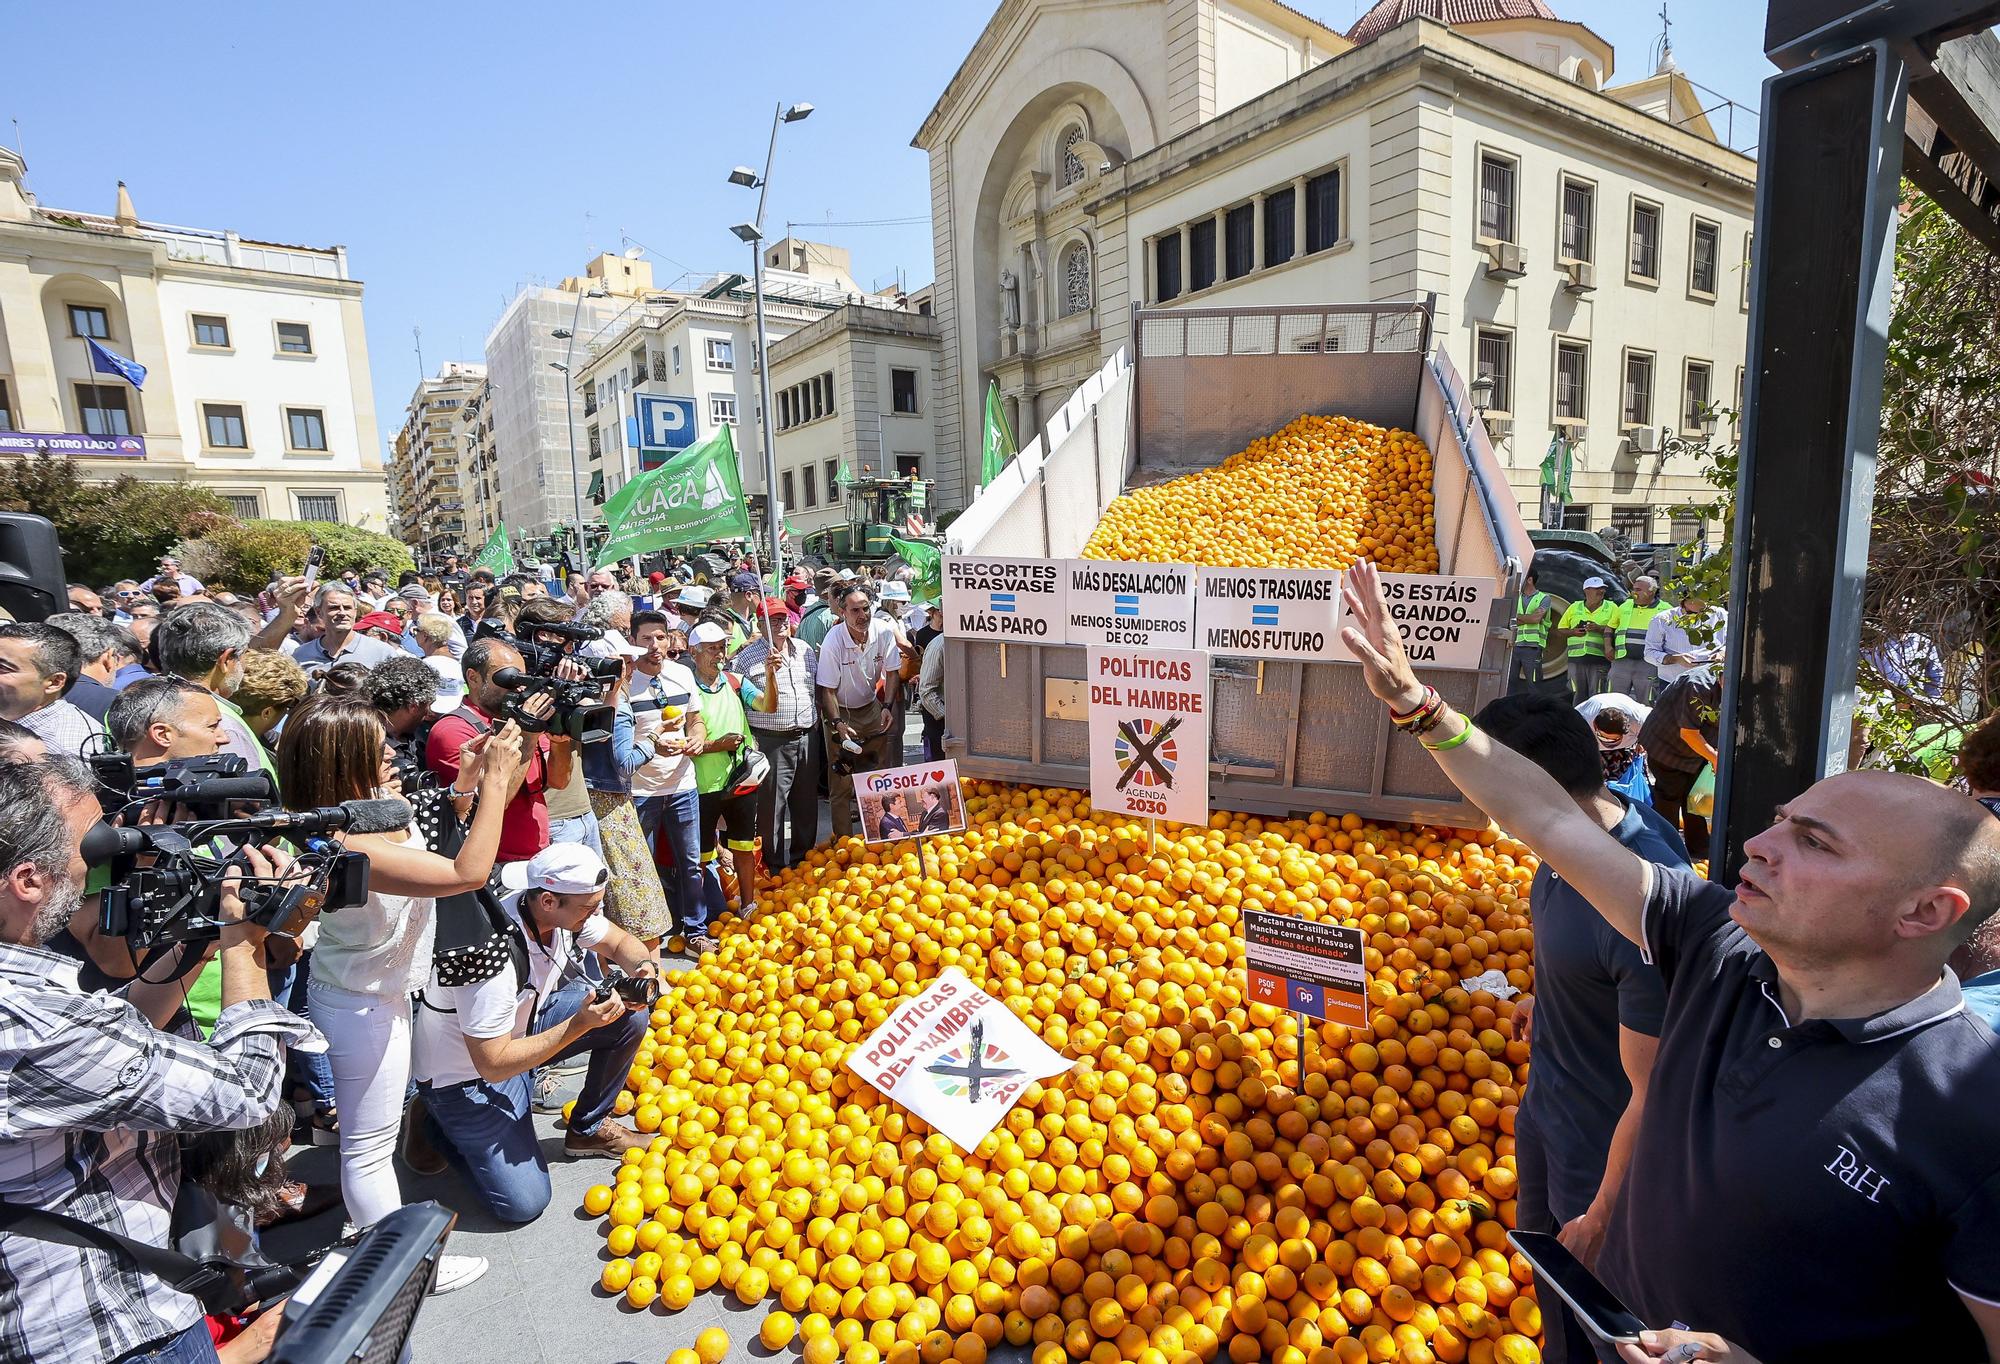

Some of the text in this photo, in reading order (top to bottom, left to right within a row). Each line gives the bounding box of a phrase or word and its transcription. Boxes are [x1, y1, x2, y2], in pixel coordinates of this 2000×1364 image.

[651, 401, 684, 444] P
[38, 439, 47, 448] A
[50, 440, 82, 449] OTRO
[84, 441, 117, 450] LADO
[949, 563, 1057, 579] RECORTES
[1072, 565, 1186, 595] MÁS DESALACIÓN
[951, 577, 1055, 594] TRASVASE
[1205, 577, 1332, 601] MENOS TRASVASE
[1381, 581, 1478, 603] OS ESTÁIS
[960, 610, 1047, 636] MÁS PARO
[1070, 614, 1187, 633] MENOS SUMIDEROS
[1415, 625, 1461, 642] CON
[1106, 632, 1149, 645] DE CO2
[1207, 628, 1324, 652] MENOS FUTURO
[1100, 654, 1192, 682] POLÍTICAS
[1091, 685, 1203, 713] DEL HAMBRE
[1125, 788, 1167, 801] AGENDA
[1126, 797, 1167, 815] 2030
[1250, 923, 1354, 950] Mancha cerrar el Trasvase
[1258, 915, 1343, 938] Pactan en Castilla-La
[1255, 934, 1348, 958] "de forma escalonada"
[1286, 968, 1303, 976] GRUPOS
[1313, 974, 1353, 986] REPRESENTACIÓN
[1314, 962, 1331, 970] Defensa
[1258, 977, 1276, 989] PSOE
[1298, 975, 1315, 983] CORTES
[1327, 997, 1362, 1011] Ciudadanos
[865, 982, 958, 1068] POLÍTICAS
[875, 1055, 916, 1091] DEL
[992, 1083, 1020, 1105] 20
